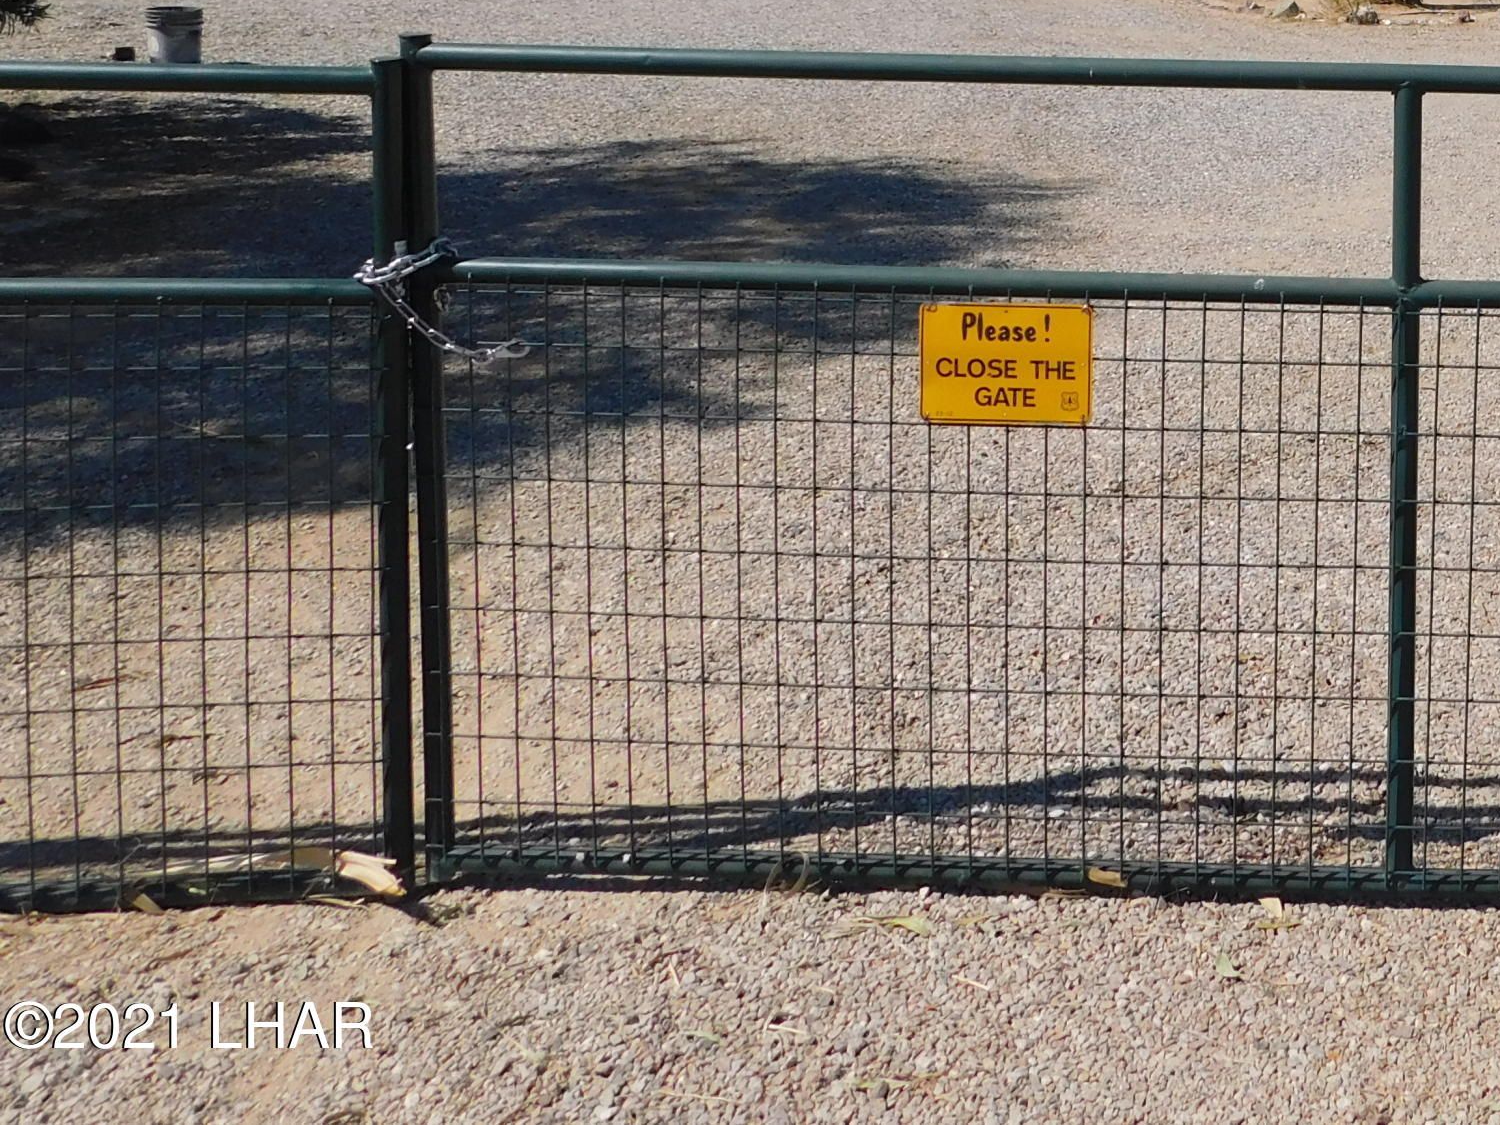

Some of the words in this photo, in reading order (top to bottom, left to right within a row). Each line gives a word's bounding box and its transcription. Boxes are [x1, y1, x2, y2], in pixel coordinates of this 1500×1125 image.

[961, 312, 1050, 342] Please!
[936, 358, 1017, 379] CLOSE
[1030, 360, 1076, 380] THE
[974, 387, 1036, 407] GATE
